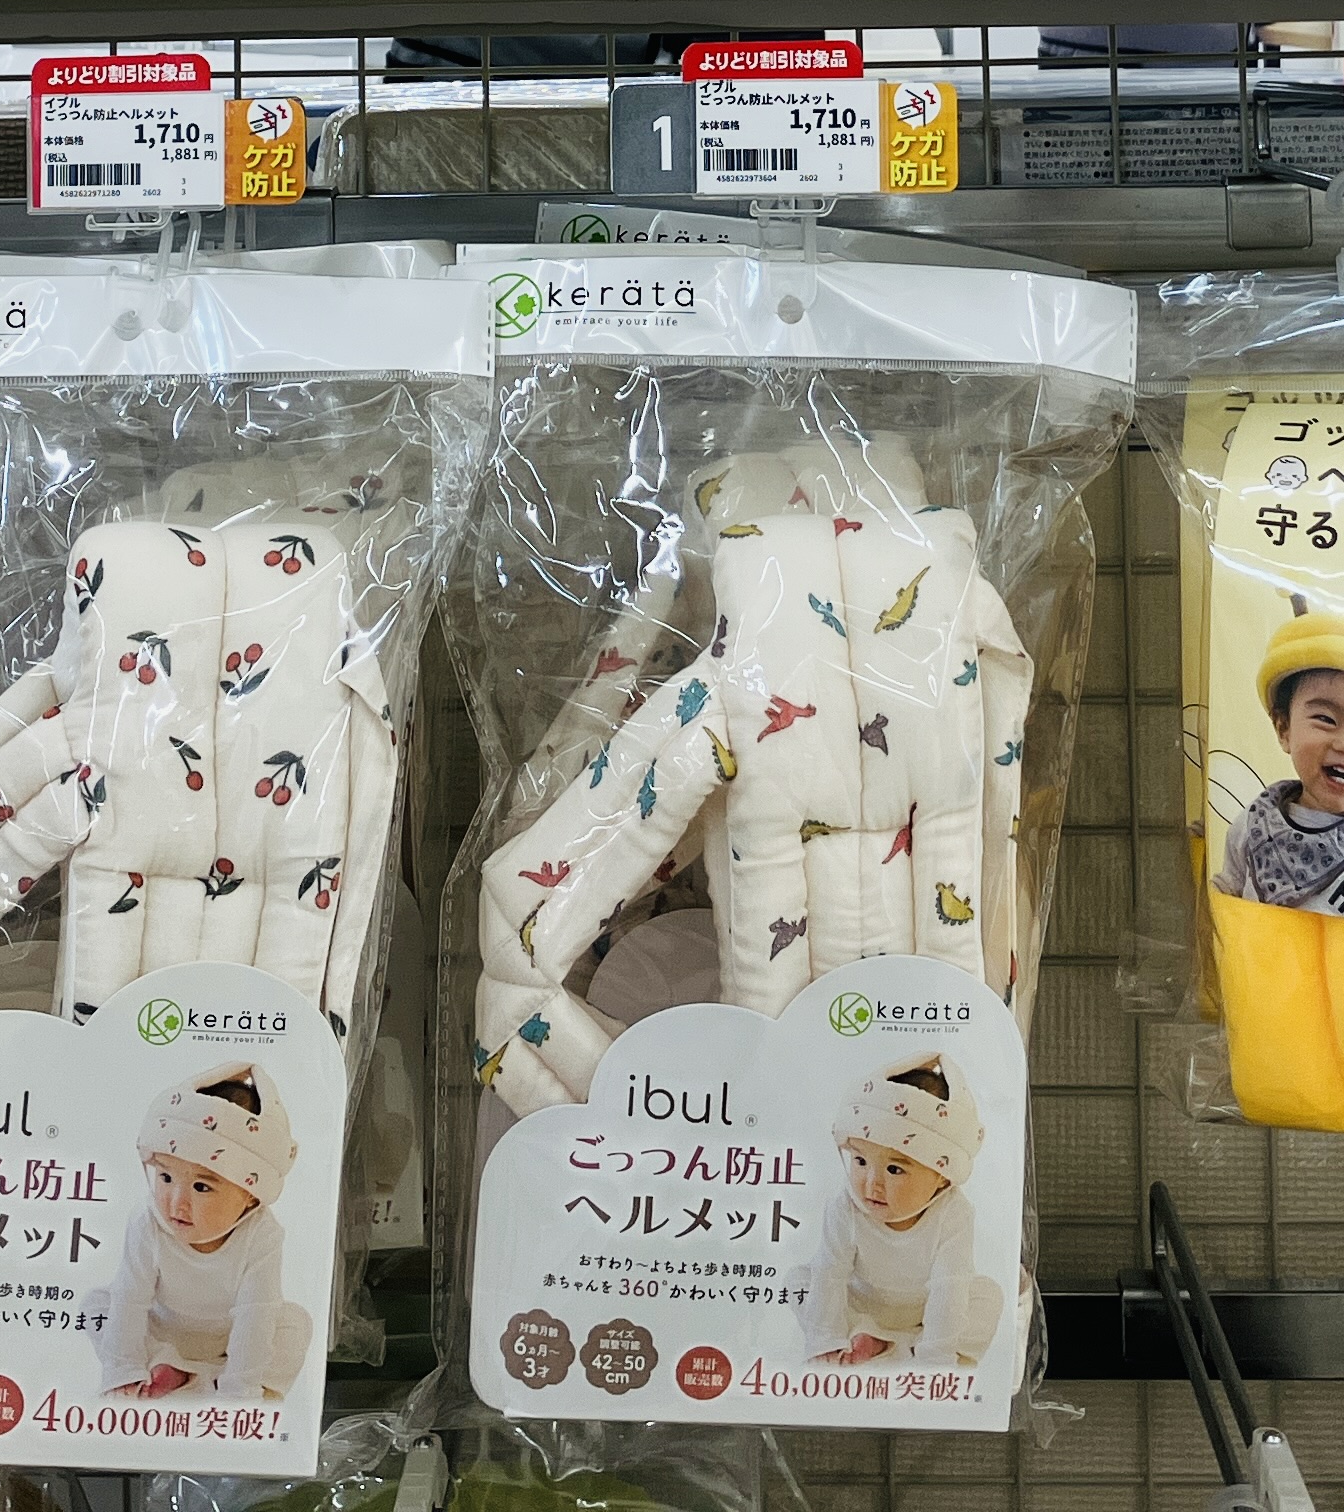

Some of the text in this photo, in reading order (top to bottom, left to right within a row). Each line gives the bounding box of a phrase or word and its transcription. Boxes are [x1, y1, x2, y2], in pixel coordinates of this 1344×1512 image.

[699, 49, 848, 71] よりどり割引対象品
[48, 63, 196, 86] よりどり割引対象品
[700, 80, 736, 93] イブル
[44, 97, 80, 108] イブル
[700, 93, 835, 106] ごっつん防止ヘルメット
[44, 108, 179, 122] ごっつん防止ヘルメット
[700, 108, 856, 134] 本体価格 1,710
[44, 123, 200, 149] 本体価格 1,710
[653, 115, 672, 171] 1
[818, 133, 856, 146] 1,881
[891, 130, 944, 157] ケガ
[162, 148, 200, 160] 1,881
[243, 144, 296, 168] ケガ
[242, 172, 298, 198] 防止
[890, 159, 947, 188] 防止
[547, 281, 695, 307] kerätä
[188, 1009, 287, 1033] kerätä
[876, 1000, 971, 1022] kerätä
[628, 1074, 732, 1126] ibul
[568, 1134, 806, 1186] ごっつん防止
[564, 1194, 801, 1243] ヘルメット
[544, 1273, 810, 1306] 赤ちゃんを かわいく守ります
[605, 1370, 630, 1385] cm
[740, 1357, 975, 1402] 40,000個突破!
[33, 1388, 279, 1441] 40,000個突破!
